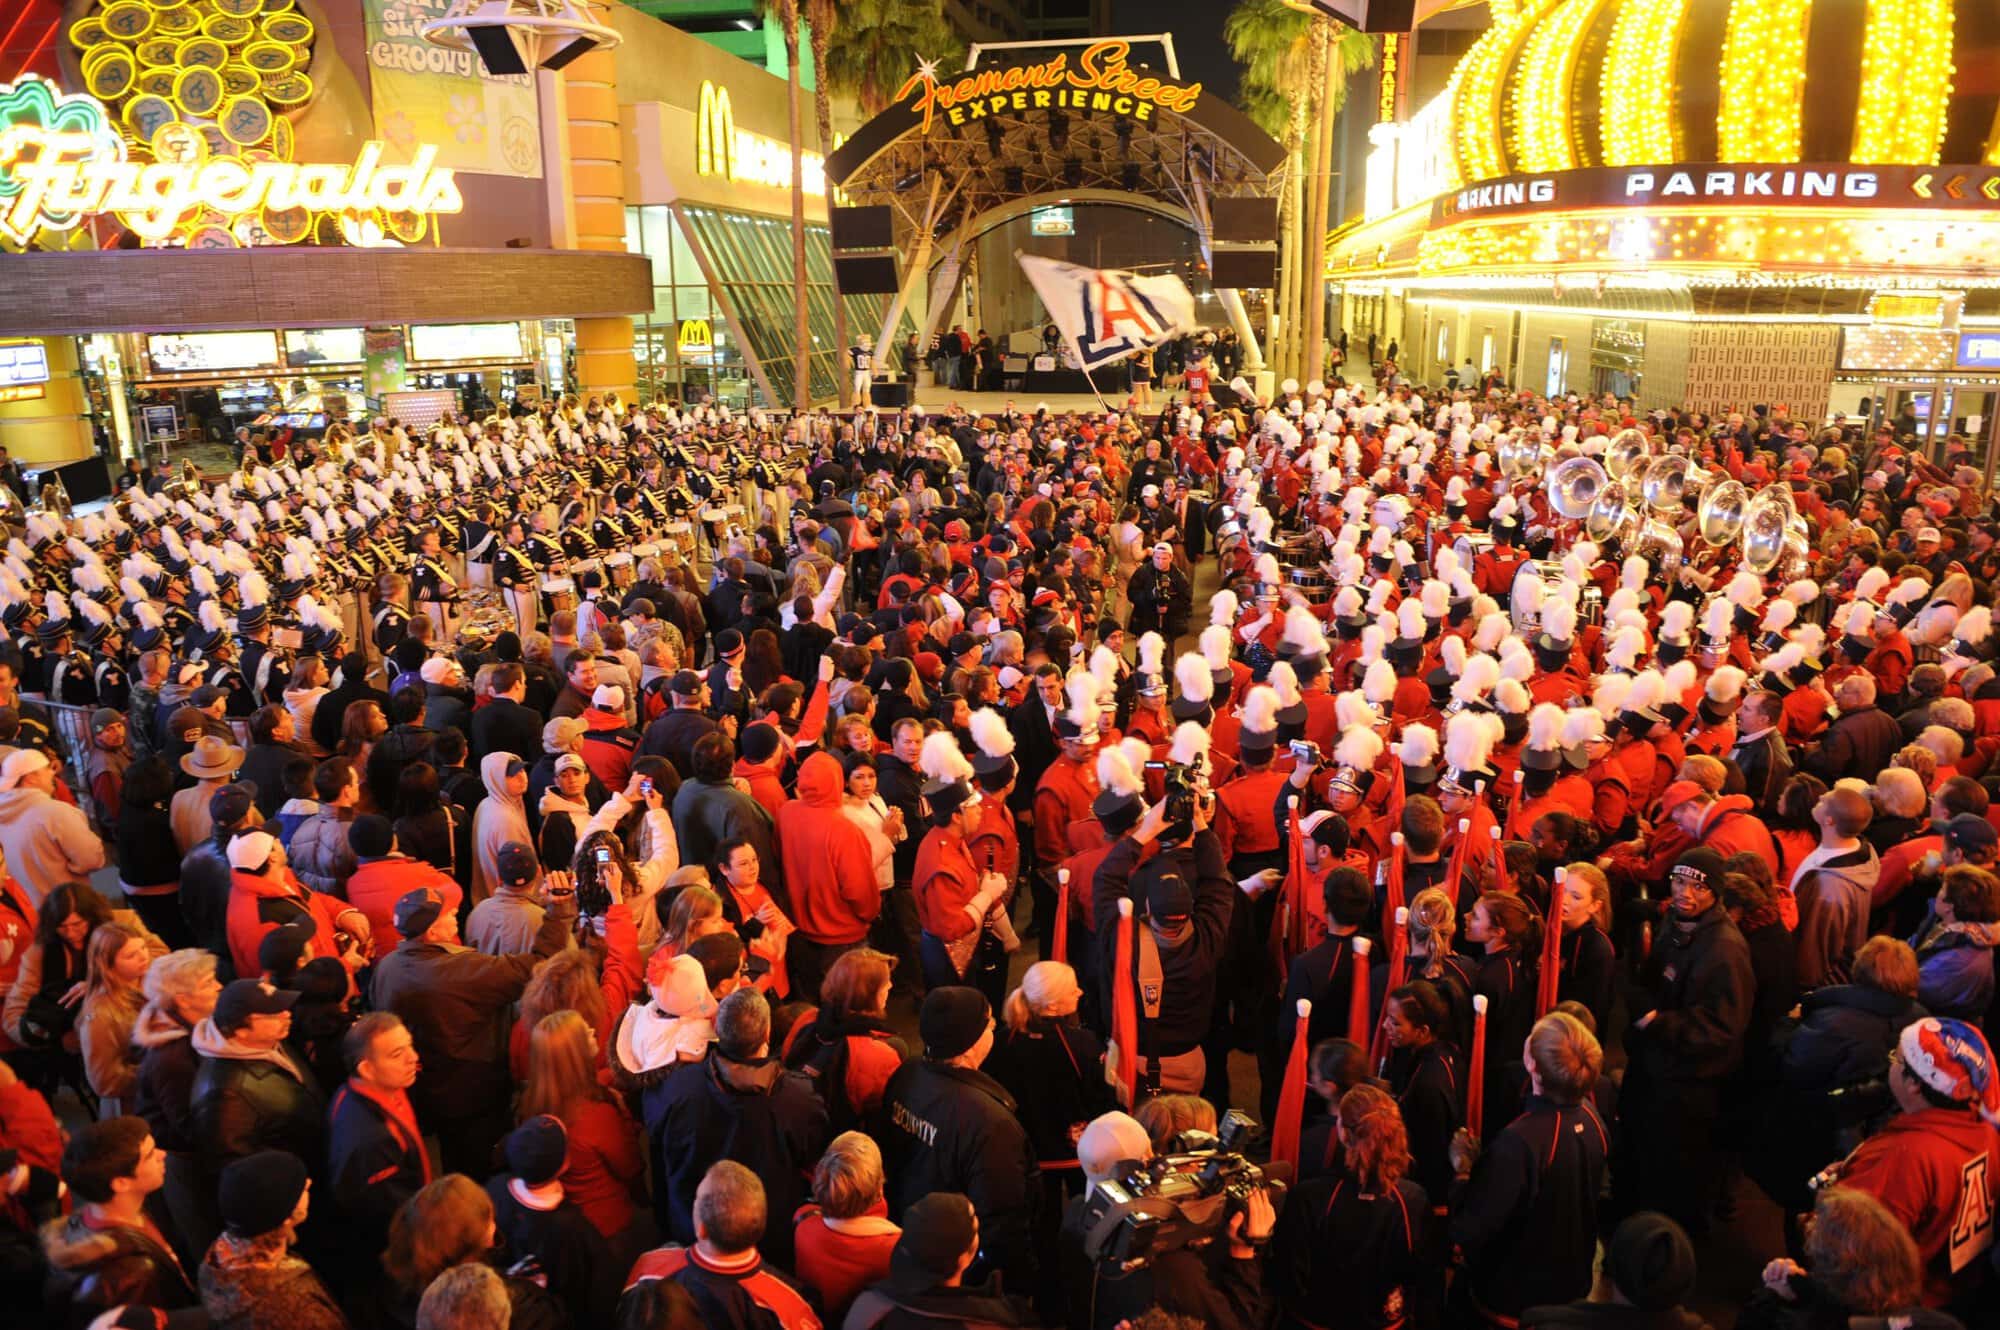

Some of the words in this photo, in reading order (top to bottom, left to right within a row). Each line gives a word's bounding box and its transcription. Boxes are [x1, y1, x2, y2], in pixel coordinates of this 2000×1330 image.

[371, 41, 473, 77] GROOVY
[1381, 32, 1398, 122] NTRANCE
[896, 52, 1067, 135] Fremont
[1066, 40, 1202, 112] Street
[948, 89, 1154, 126] EXPERIENCE
[1625, 171, 1878, 198] PARKING
[1672, 864, 1707, 882] SECURITY
[892, 1100, 938, 1147] SECURITY
[1952, 1153, 1992, 1250] A
